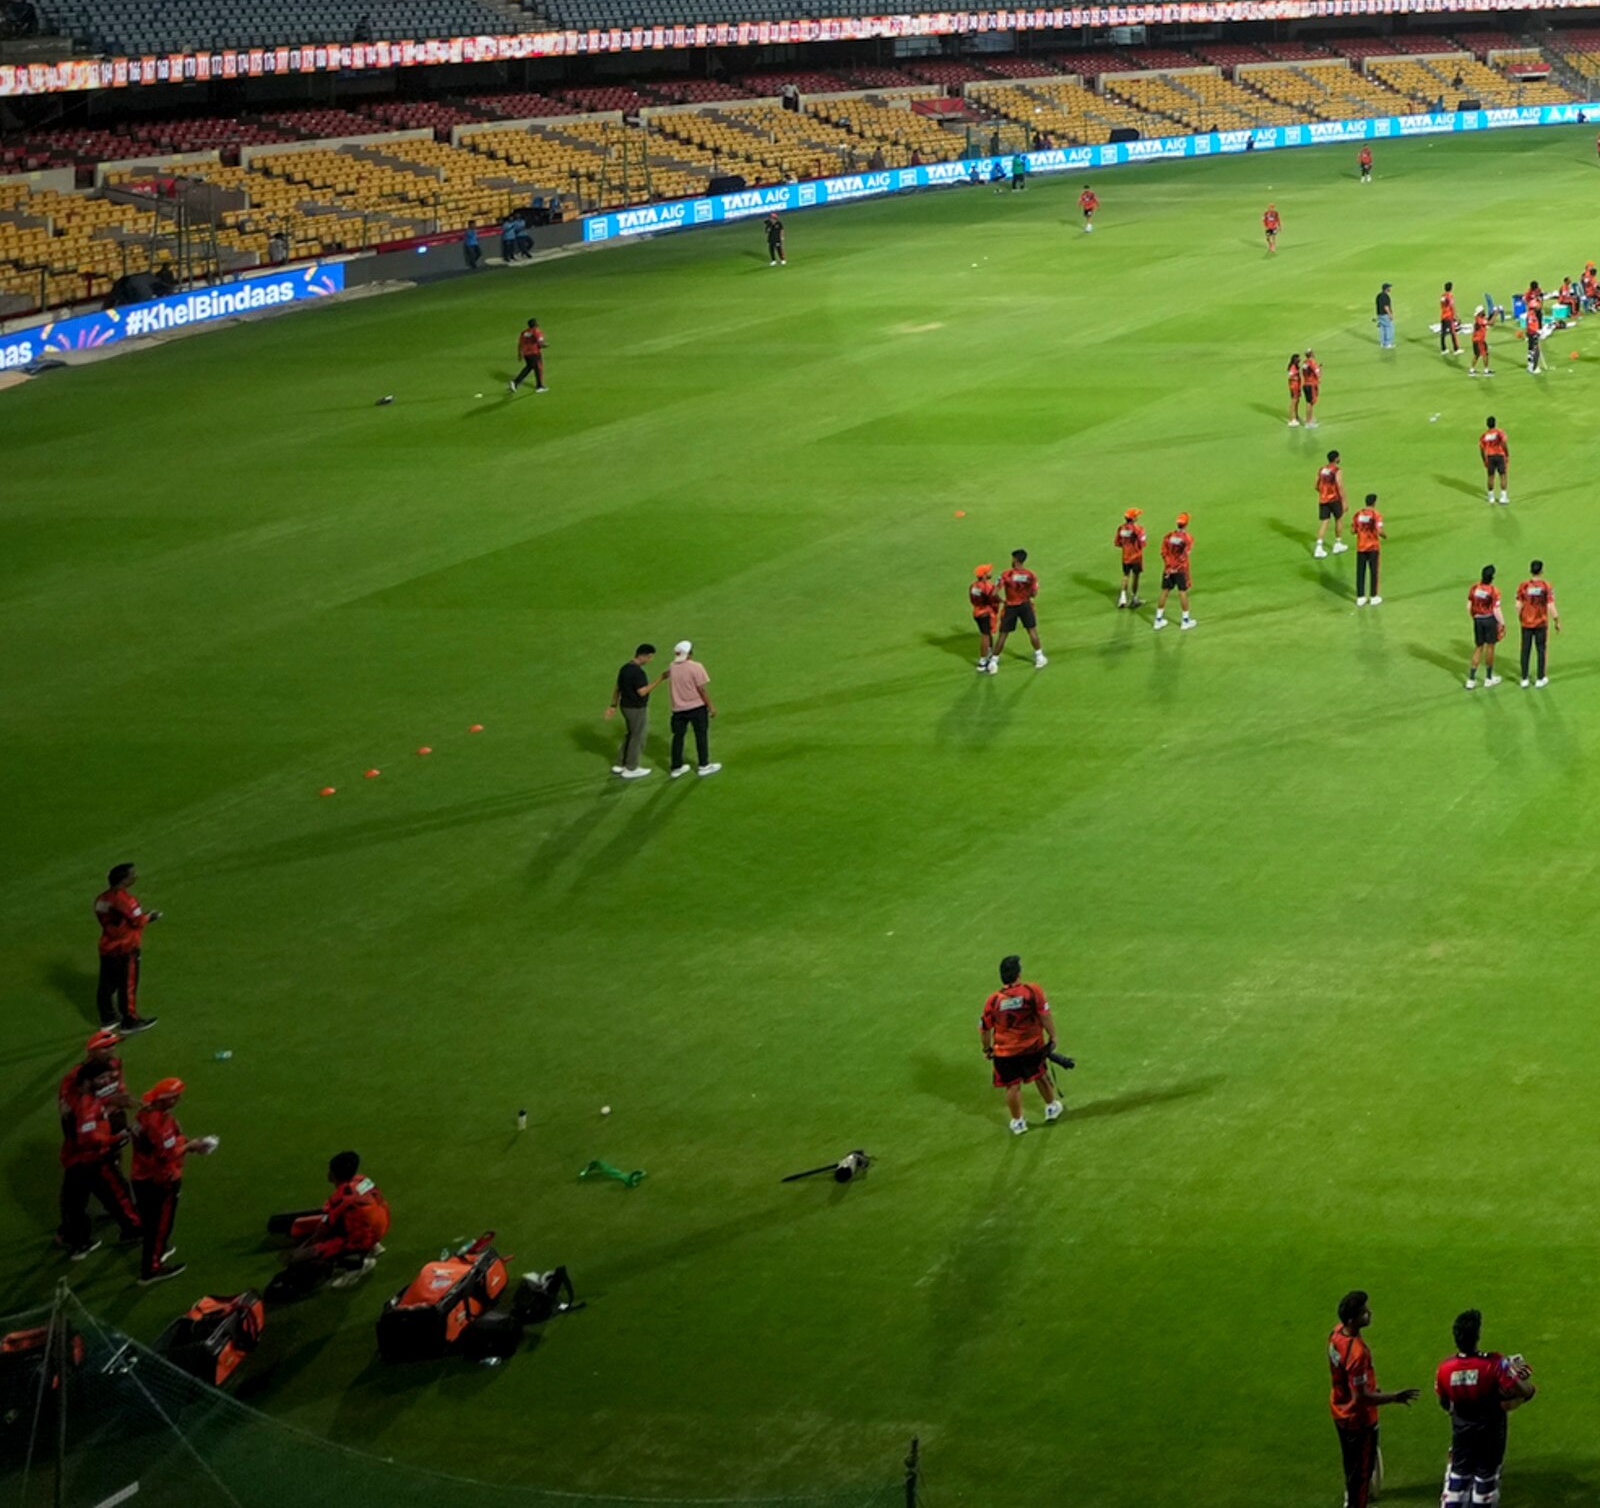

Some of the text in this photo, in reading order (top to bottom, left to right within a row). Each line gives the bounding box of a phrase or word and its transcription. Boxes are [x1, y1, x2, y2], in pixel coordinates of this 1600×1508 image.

[1399, 113, 1456, 130] TATA AIG
[1486, 108, 1521, 123] TATA
[1523, 107, 1542, 120] AIG
[1256, 130, 1278, 142] AIG
[1308, 119, 1368, 135] TATA AIG
[1125, 137, 1187, 155] TATA AIG
[1028, 153, 1066, 169] TATA
[1069, 147, 1093, 161] AIG
[926, 163, 964, 180] TATA
[824, 179, 864, 196] TATA
[867, 172, 891, 188] AIG
[721, 194, 763, 212] TATA
[765, 188, 790, 203] AIG
[616, 212, 659, 230] TATA
[660, 204, 686, 222] AIG
[125, 281, 295, 336] #KhelBindaas
